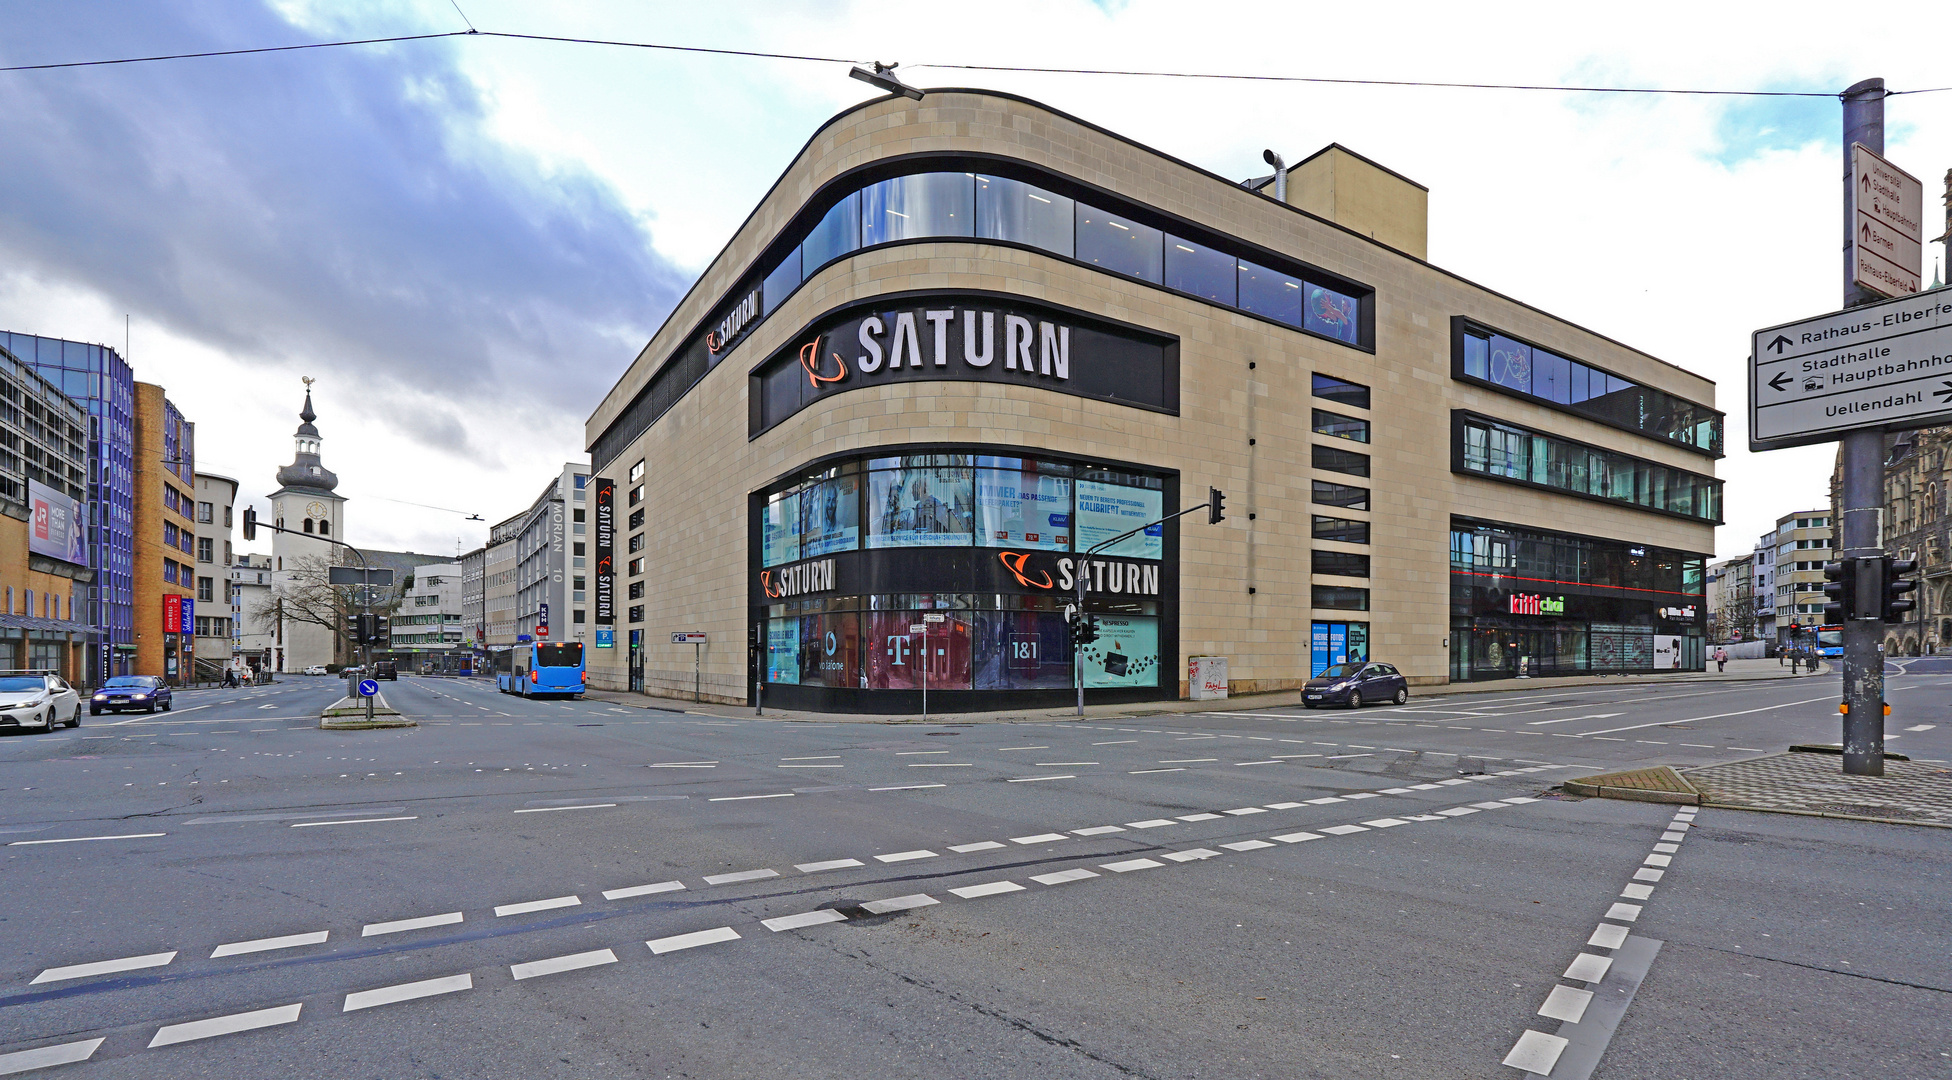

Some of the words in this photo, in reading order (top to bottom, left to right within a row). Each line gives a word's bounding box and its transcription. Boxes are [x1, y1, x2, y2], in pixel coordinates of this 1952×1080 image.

[1873, 162, 1902, 189] Universität
[1873, 179, 1900, 203] Stadthalle
[1883, 203, 1918, 232] Hauptbahnhof
[1873, 230, 1894, 252] Barmen
[1860, 259, 1908, 292] Rathaus-Elberfeld
[720, 290, 759, 347] SATURN
[858, 309, 1070, 380] SATURN
[1802, 347, 1891, 372] Stadthalle
[1825, 391, 1923, 417] Uellendahl
[37, 506, 47, 525] JR
[51, 507, 65, 520] MORE
[51, 517, 65, 531] THAN
[599, 505, 611, 547] SATURN
[553, 503, 563, 552] MORIAN
[553, 567, 563, 583] 10
[780, 559, 835, 597] SATURN
[1057, 557, 1159, 595] SATURN
[599, 575, 611, 617] SATURN
[1102, 619, 1129, 627] NESPRESSO
[1012, 641, 1037, 659] 1&1
[819, 659, 844, 671] vodafone
